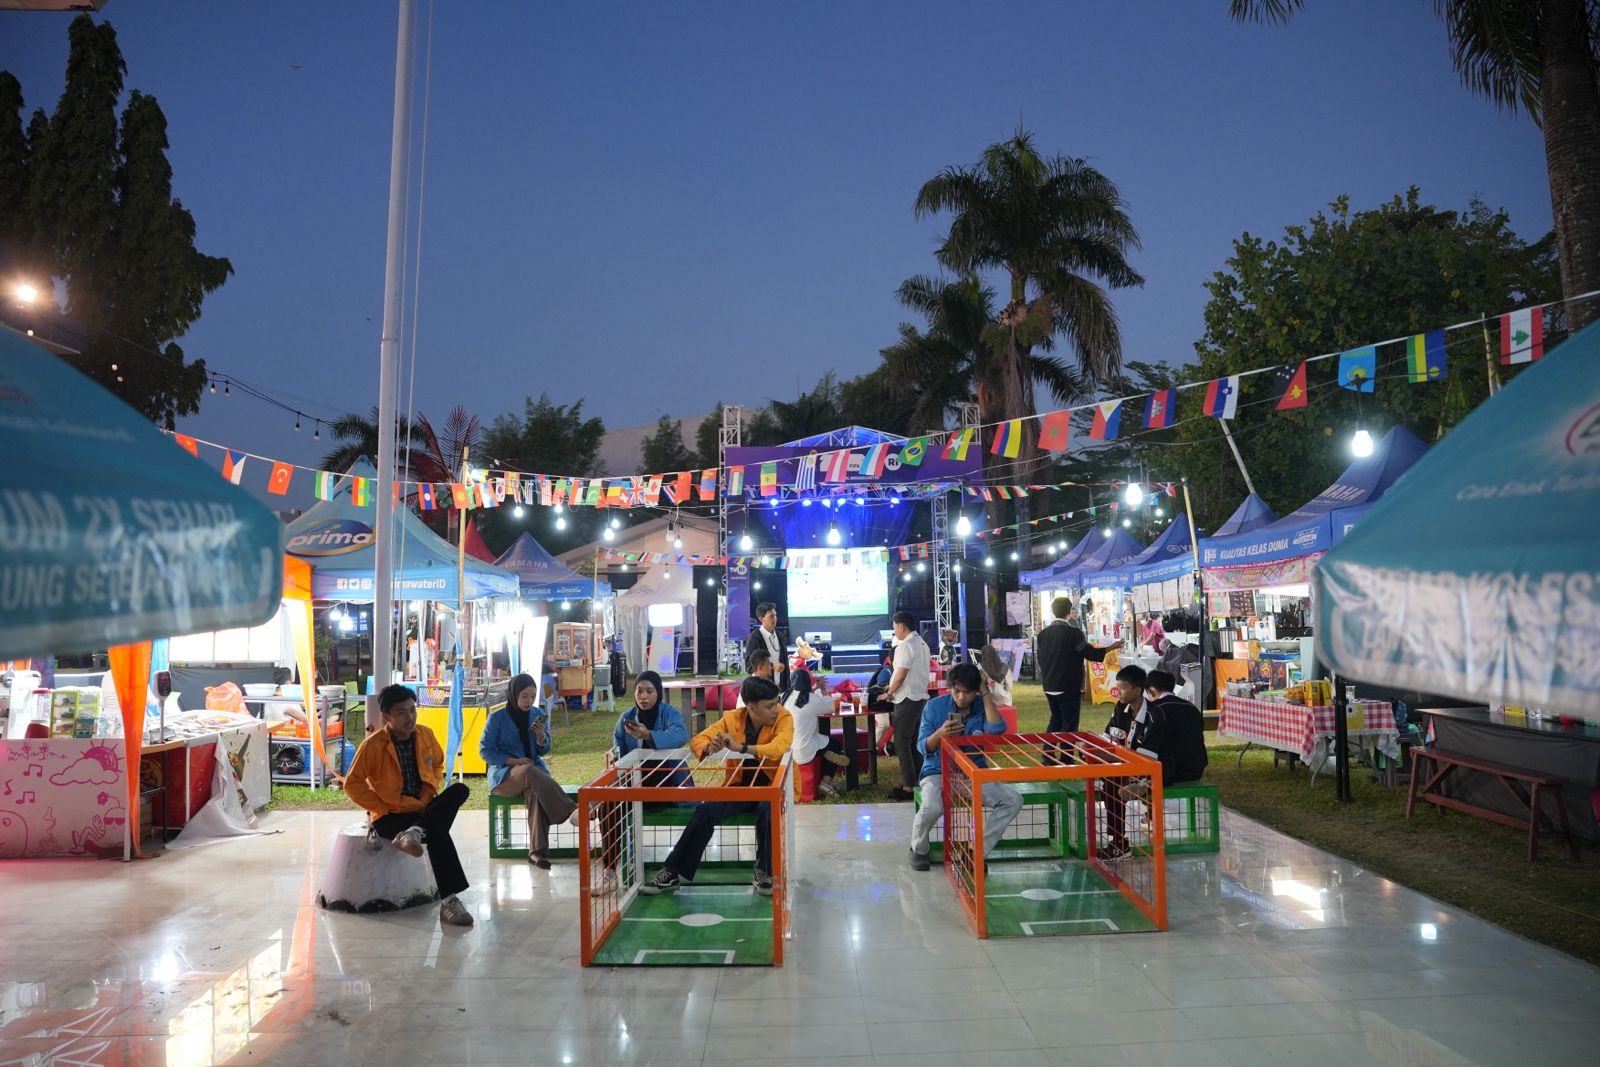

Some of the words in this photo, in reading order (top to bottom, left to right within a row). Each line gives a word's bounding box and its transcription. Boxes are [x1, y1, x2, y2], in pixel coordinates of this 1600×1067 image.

[286, 529, 373, 548] prima
[1219, 546, 1247, 560] KUALITAS
[1247, 542, 1268, 556] KELAS
[1268, 538, 1289, 552] DUNIA
[504, 559, 549, 569] YAMAHA
[527, 587, 552, 595] DUNIA
